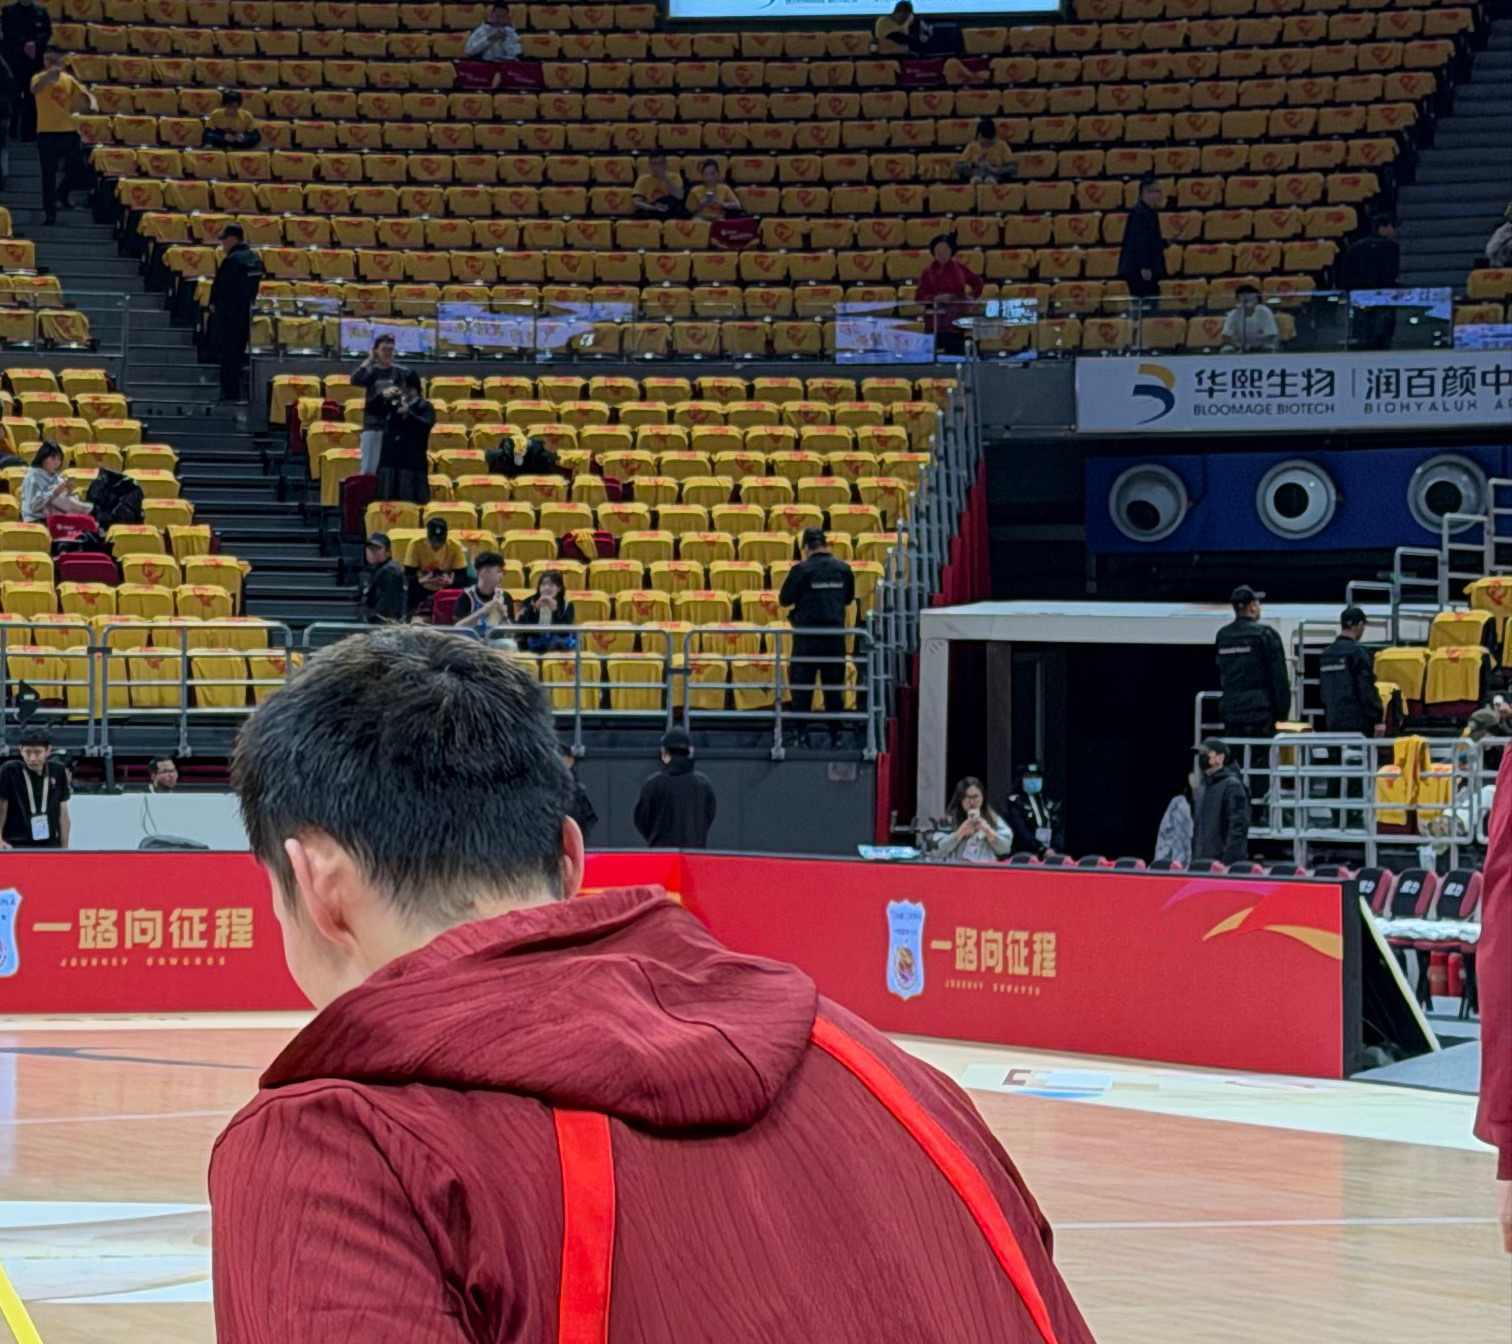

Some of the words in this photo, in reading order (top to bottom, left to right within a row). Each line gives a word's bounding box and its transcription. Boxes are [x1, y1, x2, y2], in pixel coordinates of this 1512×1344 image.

[1193, 367, 1335, 399] 华熙生物
[1366, 364, 1512, 401] 润百颜中
[1193, 403, 1273, 417] BLOOMAGE
[1277, 402, 1335, 416] BIOTECH
[32, 908, 254, 949] 一路向征程
[930, 926, 1056, 977] 一路向征程
